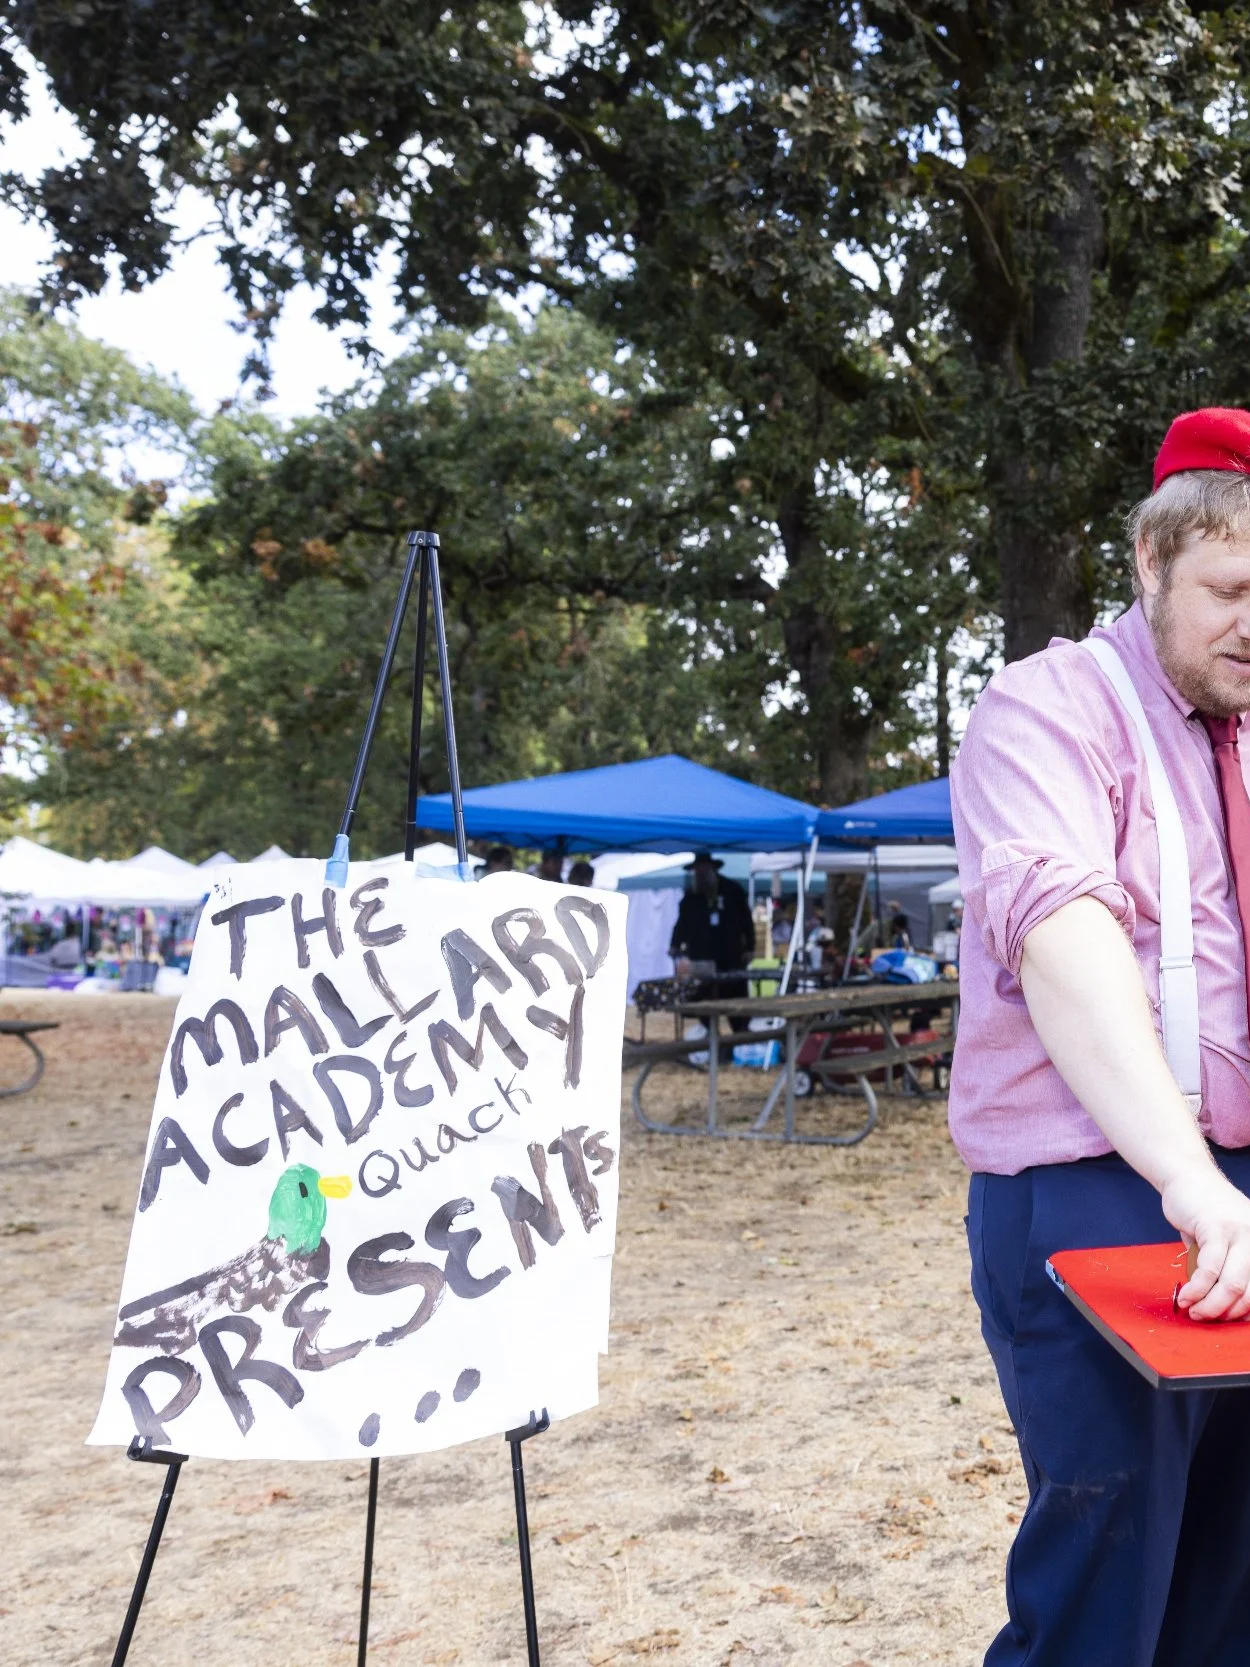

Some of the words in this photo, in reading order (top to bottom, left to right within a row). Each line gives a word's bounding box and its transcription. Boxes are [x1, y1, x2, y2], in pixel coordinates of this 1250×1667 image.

[170, 896, 611, 1098] MALLARD
[211, 877, 406, 981] THE
[138, 985, 585, 1213] ACADEMY
[357, 1072, 533, 1199] Quack
